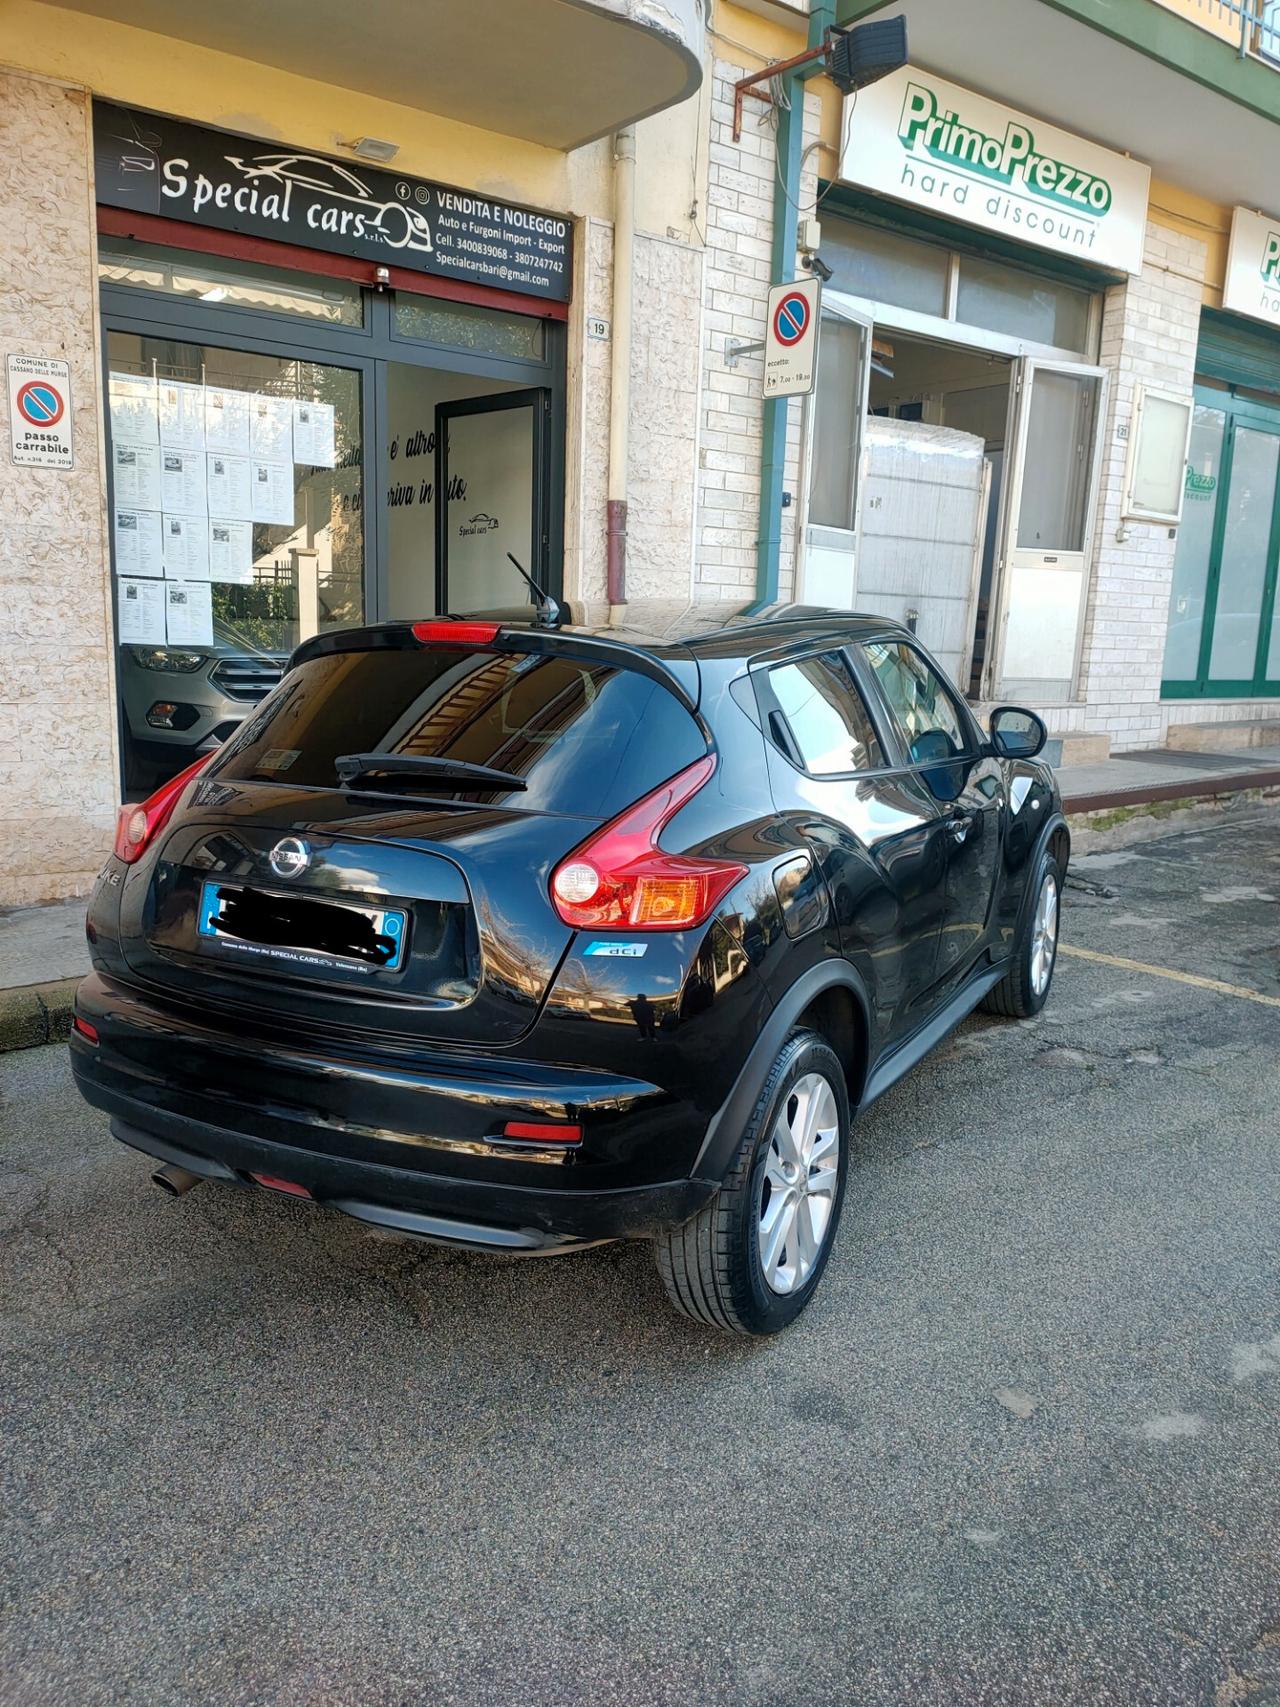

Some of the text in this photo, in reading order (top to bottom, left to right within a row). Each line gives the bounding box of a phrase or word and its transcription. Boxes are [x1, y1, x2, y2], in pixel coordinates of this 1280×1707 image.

[897, 81, 1112, 217] PrimoPrezzo
[161, 158, 366, 238] Special cars
[437, 191, 566, 238] VENDITA E NOLEGGIO
[900, 163, 1096, 248] hard discount
[438, 214, 460, 230] Auto
[461, 222, 467, 231] e
[469, 221, 501, 239] Furgoni
[503, 229, 532, 247] Import
[538, 239, 565, 255] Export
[435, 233, 454, 248] Cell.
[456, 238, 508, 260] 3400839068
[514, 251, 563, 273] 3807247742
[436, 251, 550, 287] Specialcarsbari@gmail.com
[594, 323, 605, 335] 19
[9, 365, 34, 374] CASSANO
[15, 357, 48, 368] COMUNE
[15, 432, 70, 455] passo carrabile
[270, 851, 302, 863] NISSAN
[270, 950, 299, 960] SPECIAL
[299, 955, 319, 964] CARS
